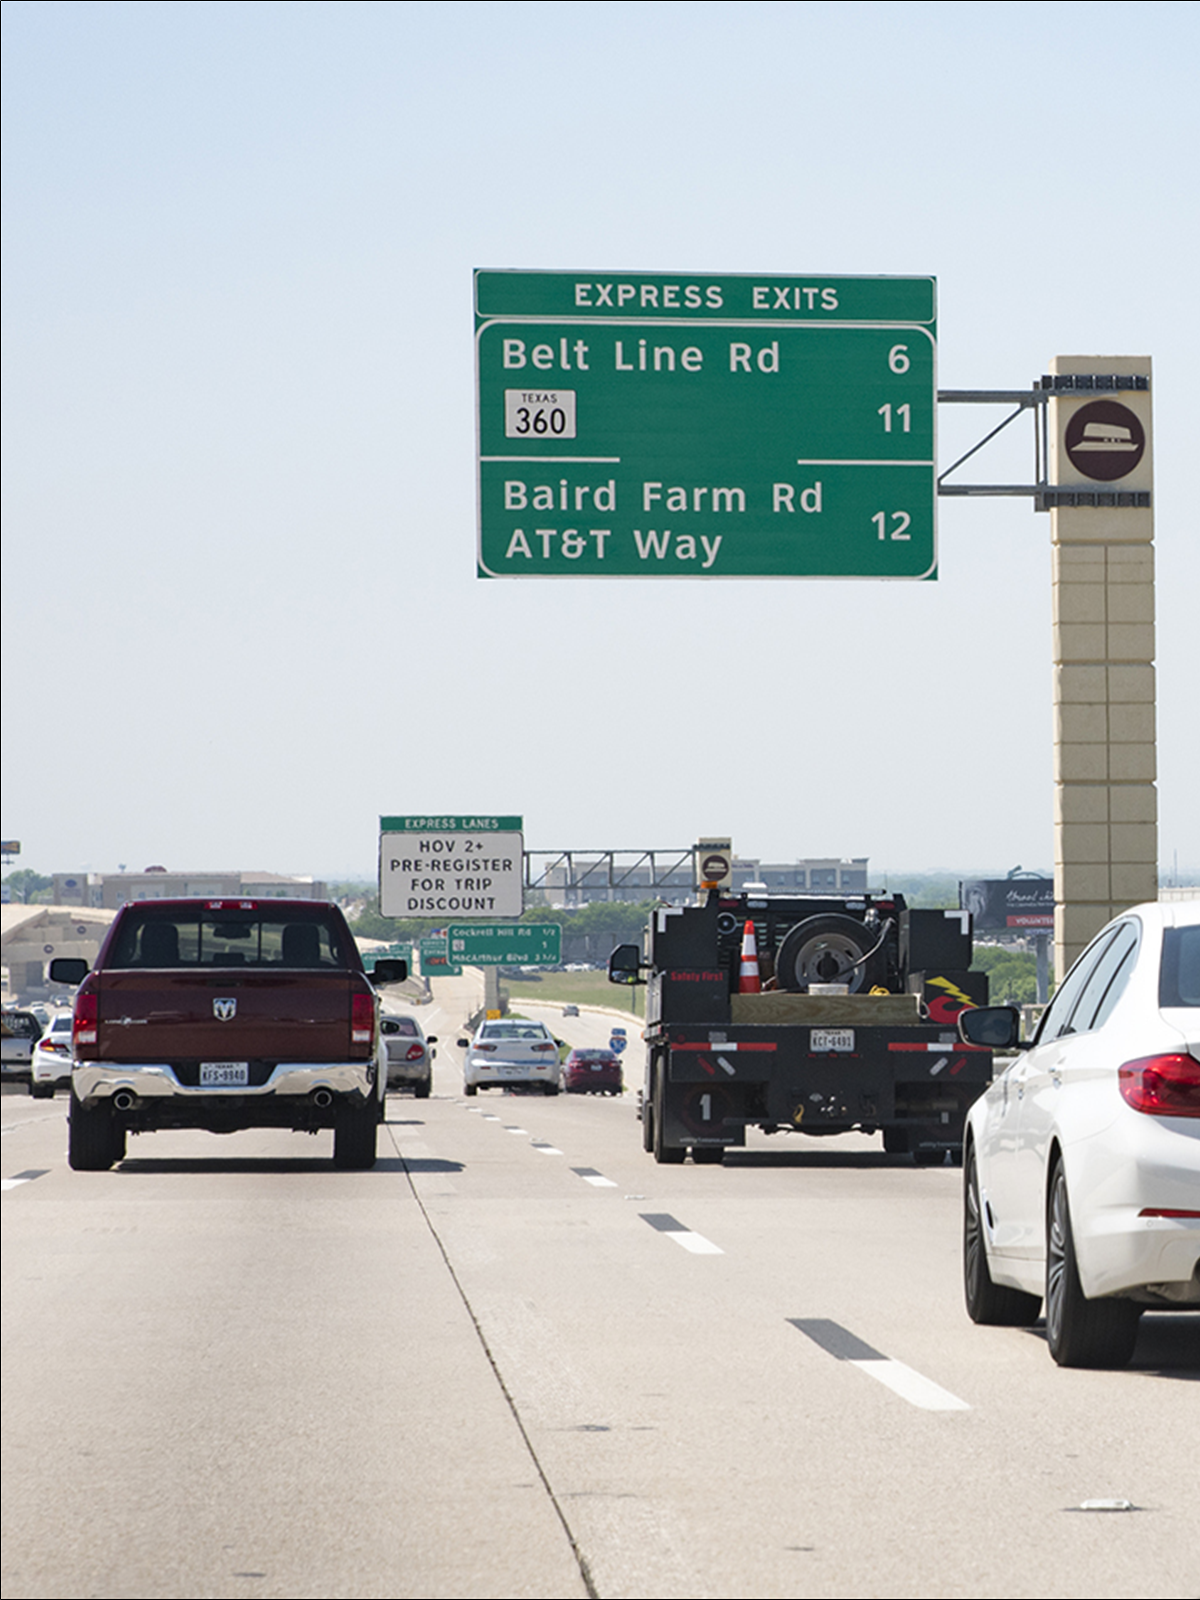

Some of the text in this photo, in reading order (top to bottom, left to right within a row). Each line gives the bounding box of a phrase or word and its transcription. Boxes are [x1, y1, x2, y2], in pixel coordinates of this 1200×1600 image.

[574, 283, 839, 310] EXPRESS EXITS
[503, 338, 780, 373] Belt Line Rd
[888, 344, 910, 374] 6
[521, 393, 558, 403] TEXAS
[515, 407, 566, 435] 360
[877, 403, 911, 432] 11
[504, 480, 823, 513] Baird Farm Rd
[871, 511, 911, 541] 12
[505, 528, 722, 568] AT&T Way
[405, 818, 499, 829] EXPRESS LANES
[419, 840, 483, 852] HOV 2+
[391, 859, 513, 871] PRE-REGISTER
[411, 878, 492, 891] FOR TRIP
[407, 898, 496, 910] DISCOUNT
[452, 928, 531, 936] Cockrell Hill Rd
[452, 954, 502, 962] MacArthur
[671, 971, 723, 982] Safety First
[700, 1094, 711, 1120] 1
